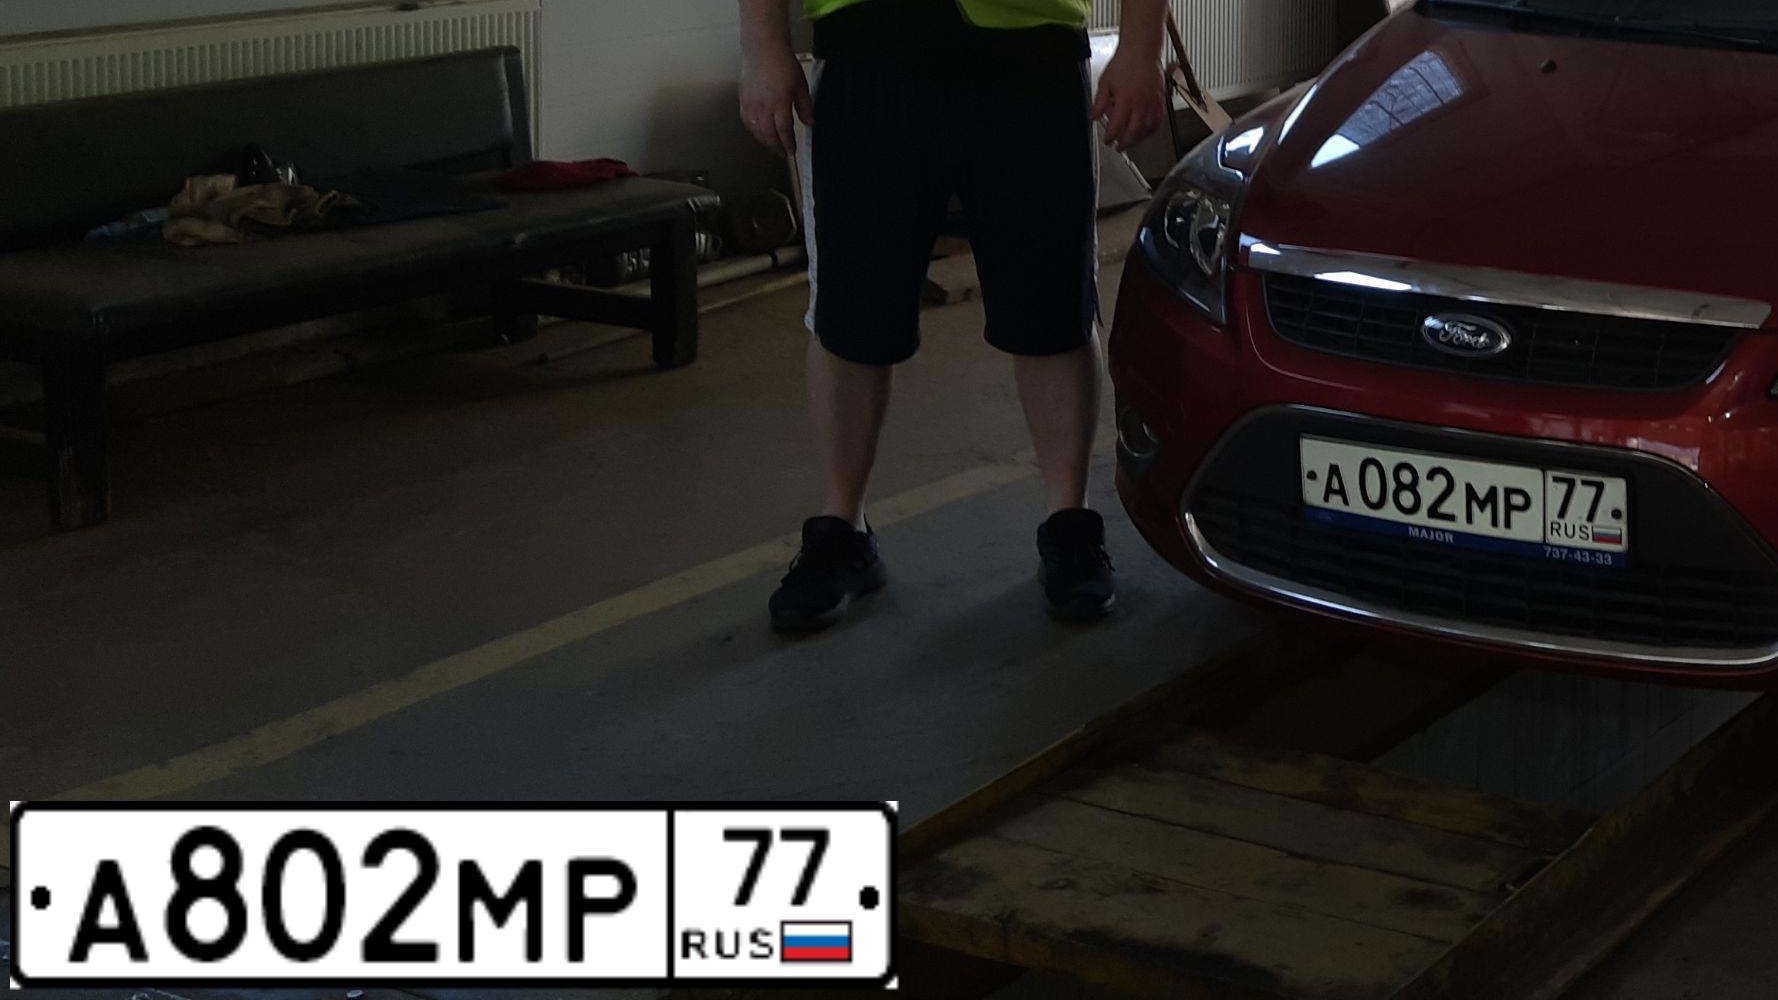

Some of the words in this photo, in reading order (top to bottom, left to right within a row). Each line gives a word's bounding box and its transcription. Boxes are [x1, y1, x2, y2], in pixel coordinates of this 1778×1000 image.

[1439, 320, 1490, 349] Ford
[1551, 475, 1606, 524] 77
[1408, 525, 1455, 544] MAJOR
[1550, 521, 1590, 541] RUS
